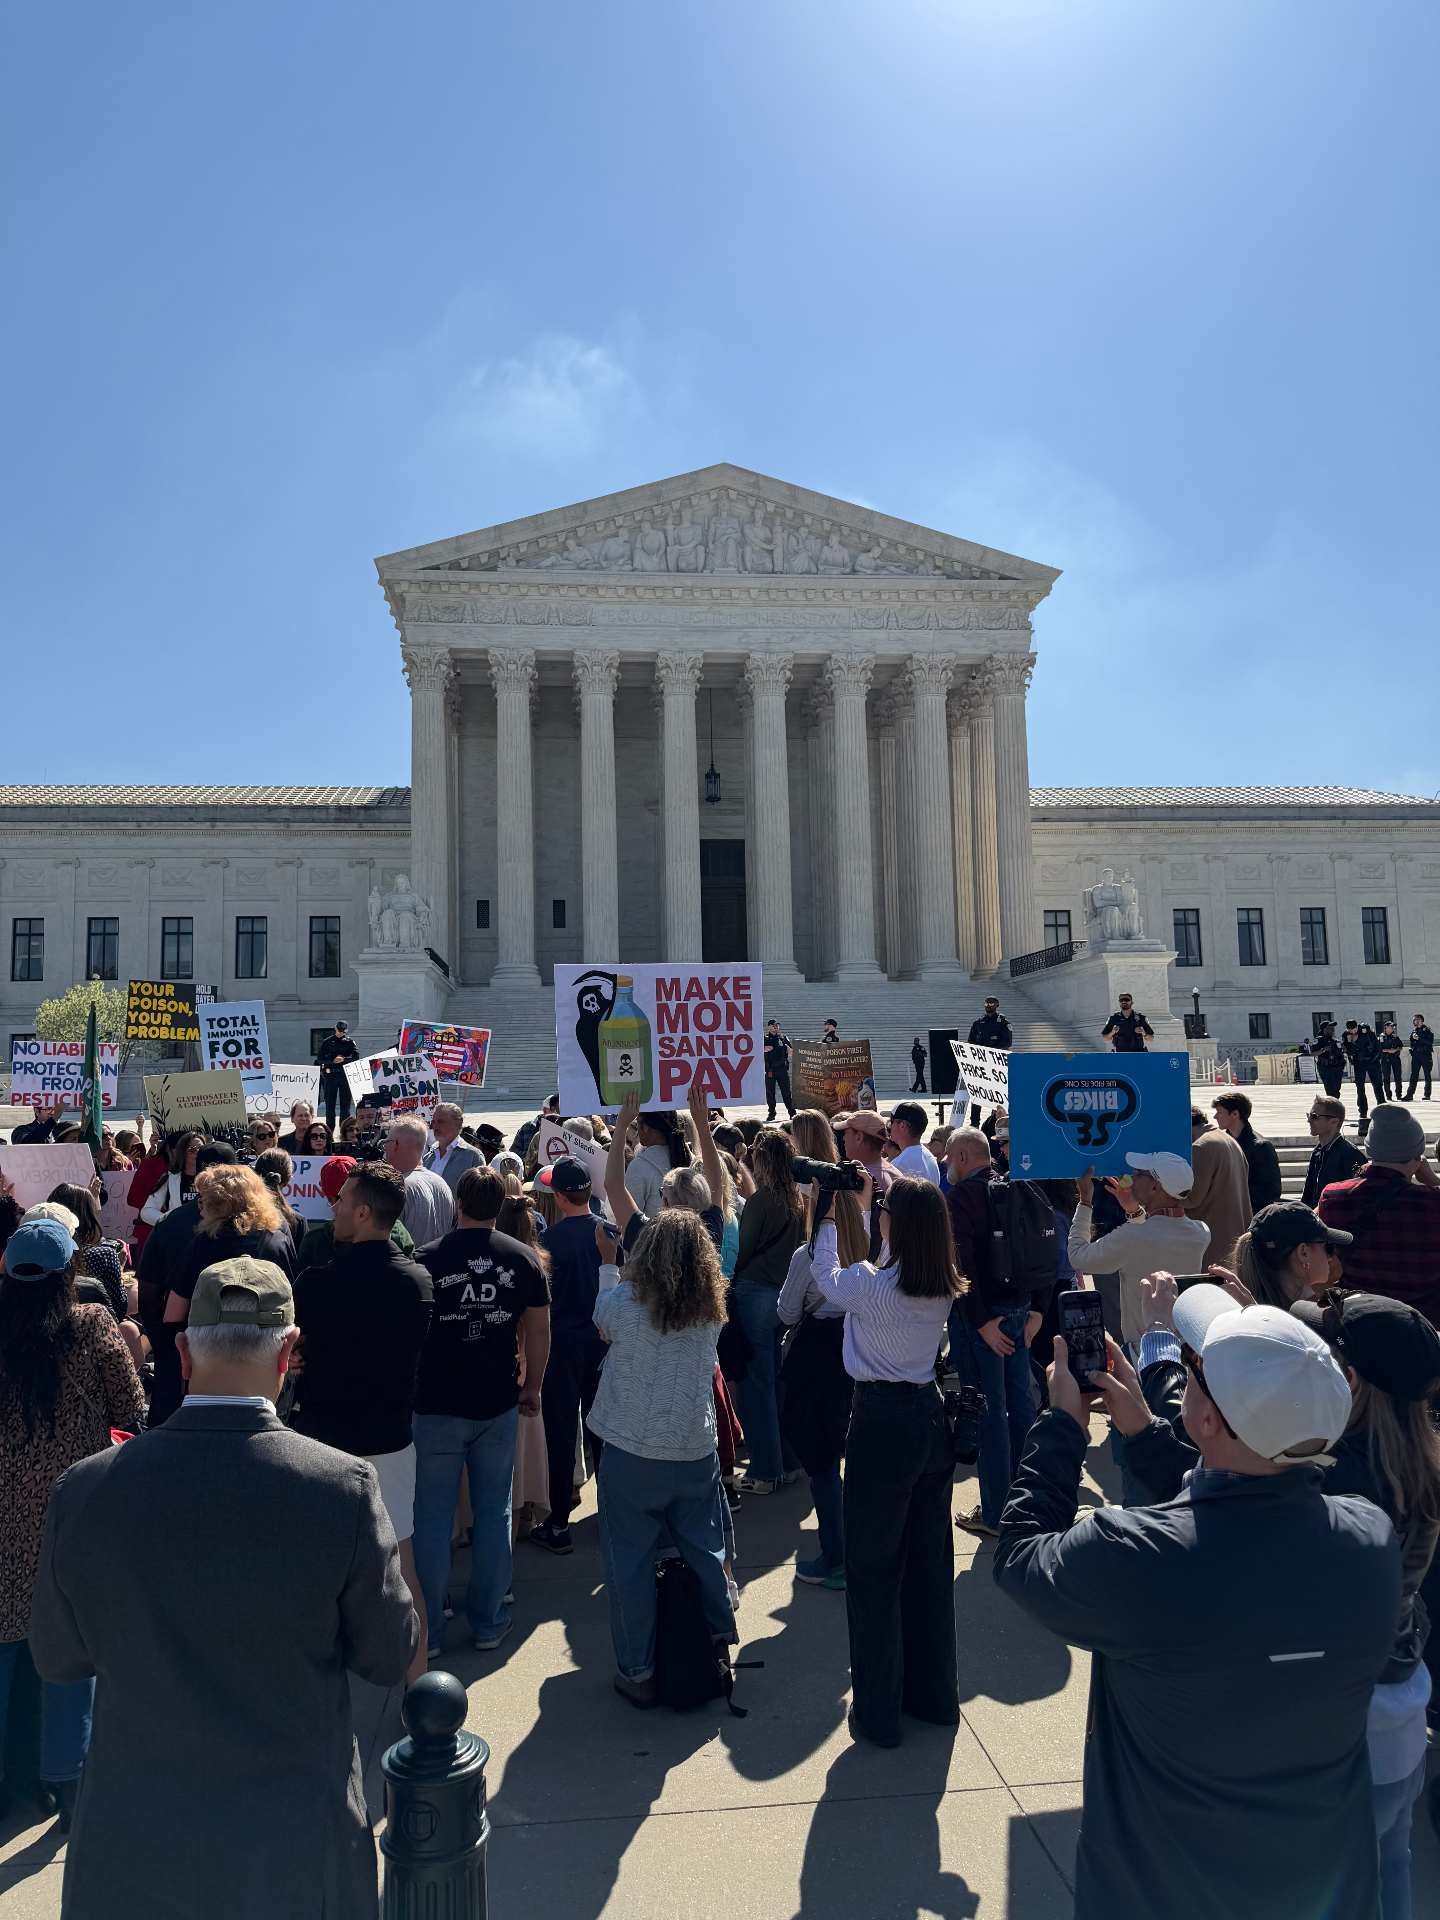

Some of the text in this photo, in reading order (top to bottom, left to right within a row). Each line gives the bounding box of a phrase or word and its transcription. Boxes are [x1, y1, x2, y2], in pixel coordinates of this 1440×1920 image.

[607, 609, 842, 625] EQUAL JUSTICE UNDER LAW
[130, 981, 175, 997] YOUR
[195, 984, 212, 995] HOLD
[655, 976, 752, 1002] MAKE
[129, 996, 193, 1017] POISON,
[195, 994, 215, 1004] BAYER
[128, 1010, 171, 1026] YOUR
[206, 1014, 260, 1030] TOTAL
[656, 1001, 753, 1034] MON
[207, 1028, 260, 1039] IMMUNITY
[13, 1042, 119, 1057] NO LIABITY
[208, 1037, 262, 1059] FOR
[602, 1036, 650, 1049] MONSANTO
[658, 1033, 754, 1059] SANTO
[826, 1047, 846, 1056] POISON
[952, 1042, 1008, 1067] WE PAY THE
[12, 1061, 118, 1076] PROTECTN
[382, 1057, 427, 1077] BAYER
[960, 1061, 1008, 1085] PRICE. SO
[399, 1074, 410, 1083] IS
[659, 1056, 755, 1103] PAY
[378, 1078, 439, 1099] POISON
[967, 1082, 1004, 1105] SHOULD
[10, 1093, 112, 1106] PESTICIS
[176, 1092, 229, 1103] GLYPHOSATE
[1064, 1090, 1118, 1111] BIKES
[1067, 1112, 1117, 1147] SE
[562, 1131, 573, 1142] KY
[573, 1137, 596, 1156] Stands
[439, 1313, 467, 1321] FieldPulse
